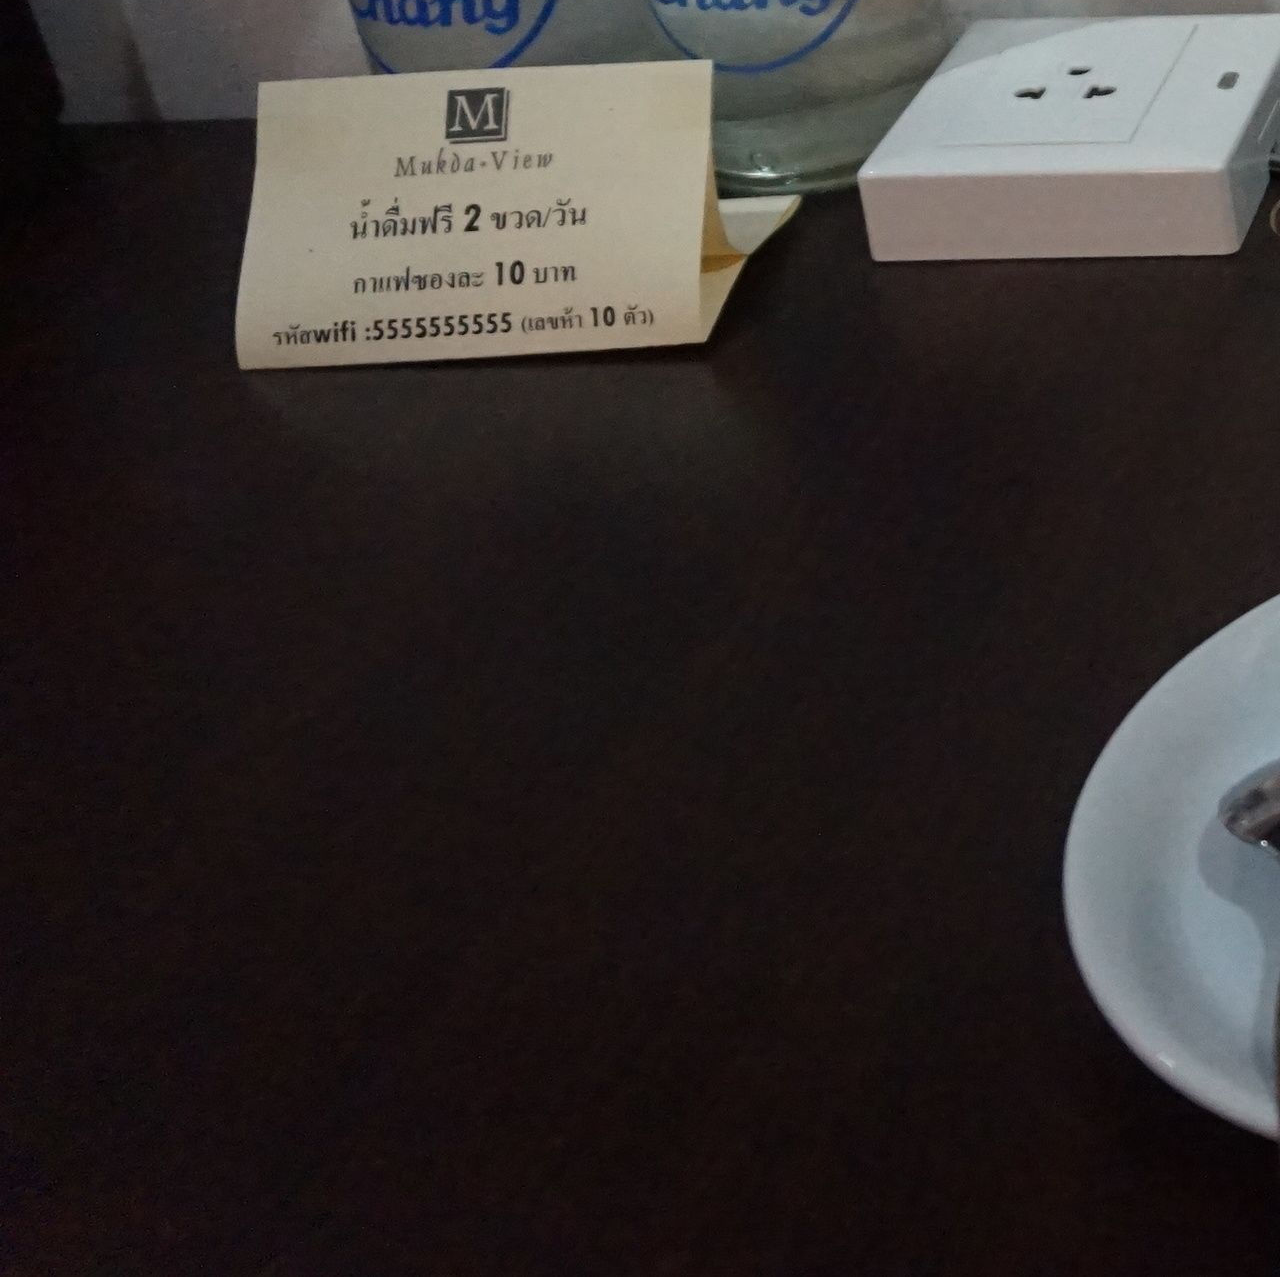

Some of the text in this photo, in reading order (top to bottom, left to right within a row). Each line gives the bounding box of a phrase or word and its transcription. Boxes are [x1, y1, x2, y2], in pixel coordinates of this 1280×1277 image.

[449, 93, 500, 132] M
[350, 197, 588, 239] น้ำดื่มฟรี 2 ขวด/วัน
[353, 260, 577, 295] กาแฟซองละ 10 บาท
[590, 306, 616, 328] 10
[623, 304, 655, 328] ตัว)
